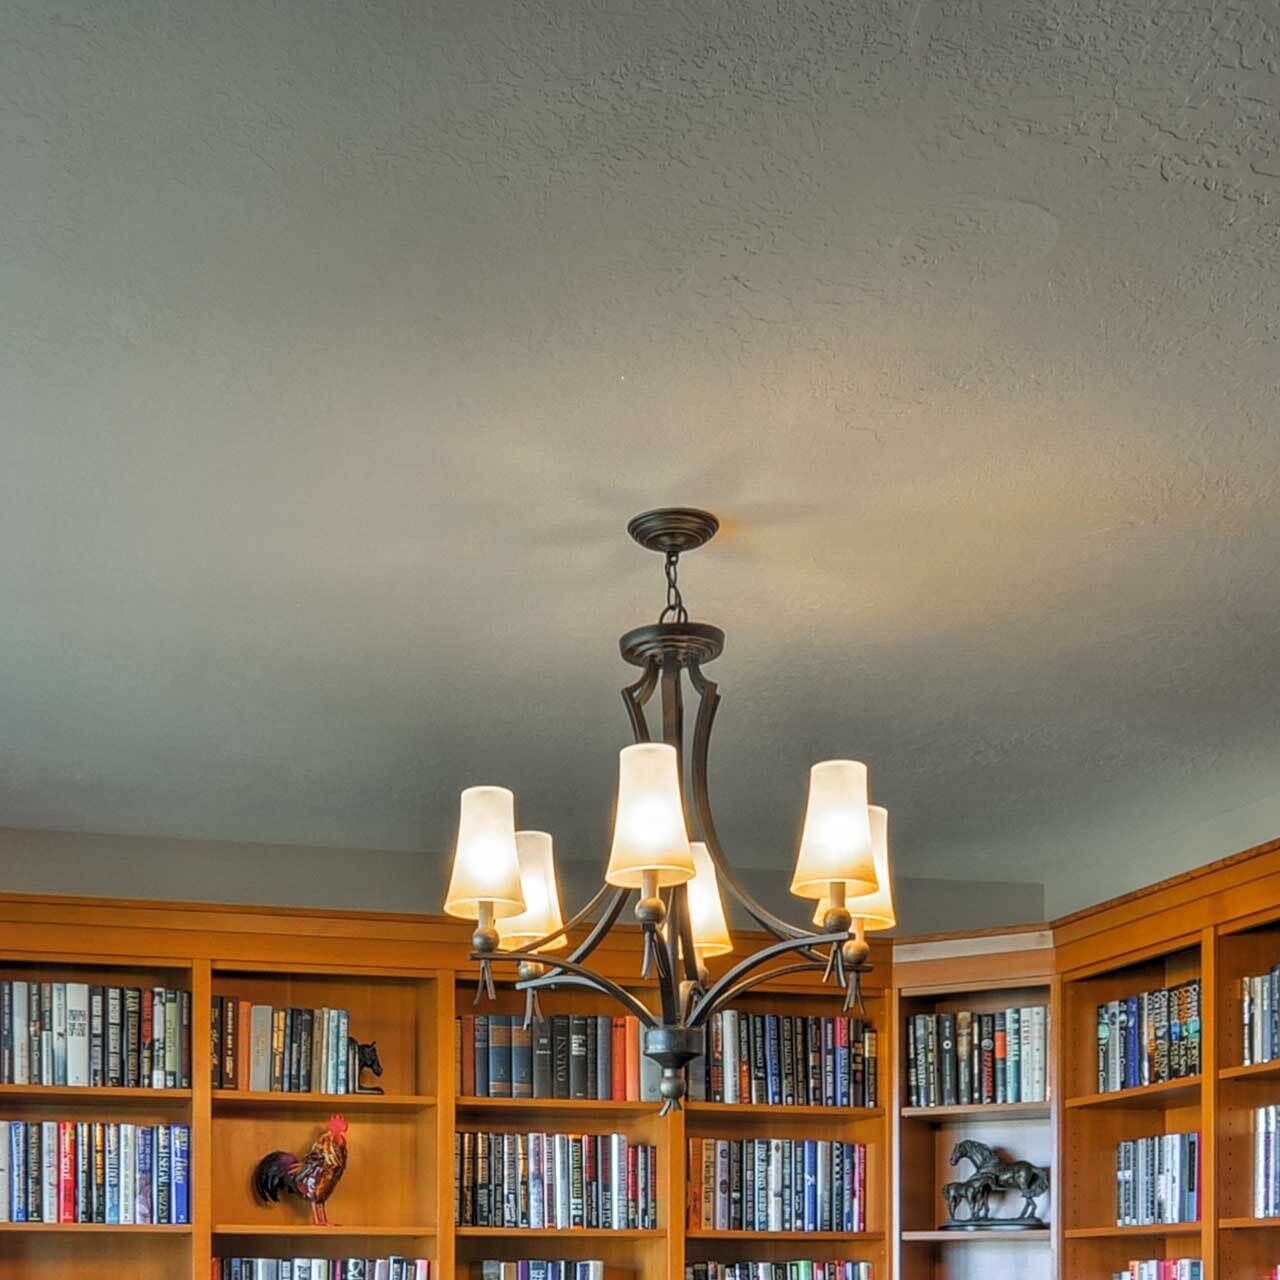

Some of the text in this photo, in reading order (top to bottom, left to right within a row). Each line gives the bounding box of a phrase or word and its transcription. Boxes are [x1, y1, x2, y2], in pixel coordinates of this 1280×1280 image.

[1022, 1019, 1031, 1047] GERMS
[557, 1036, 568, 1082] IN VIVO
[984, 1051, 993, 1096] APPALOOSA
